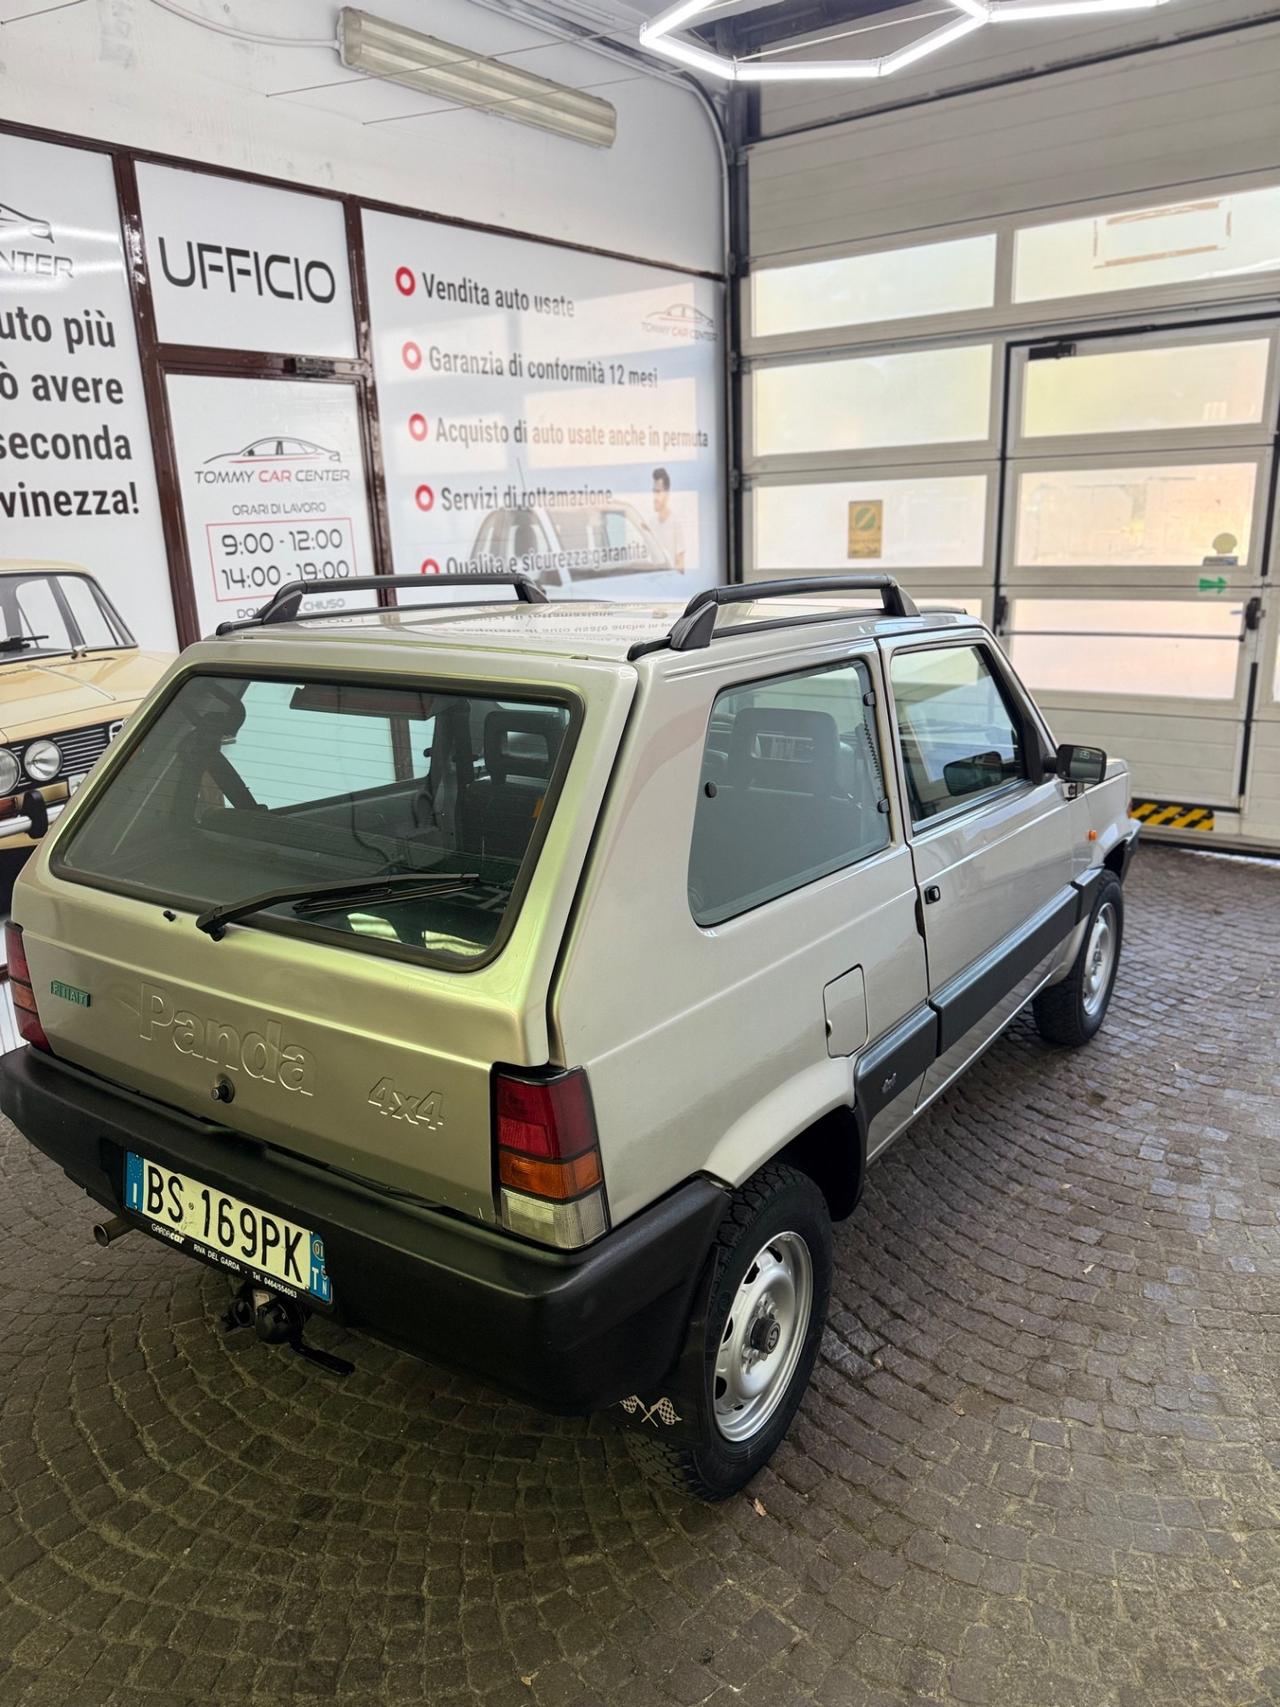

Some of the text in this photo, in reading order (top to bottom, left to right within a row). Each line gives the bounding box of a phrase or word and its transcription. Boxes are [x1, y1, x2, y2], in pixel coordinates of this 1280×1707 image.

[158, 236, 336, 304] UFFICIO
[422, 272, 575, 317] Vendita auto usate
[64, 309, 116, 354] più
[429, 346, 658, 388] Garanzia di conformità 12 mesi
[31, 373, 124, 404] avere
[436, 417, 708, 451] Acquisto di auto usate anche in permuta
[194, 468, 350, 484] TOMMY CAR CENTER
[232, 502, 327, 516] ORARI DI LAVORO
[441, 485, 613, 511] Servizi di rottamazione
[221, 532, 274, 556] 9:00
[289, 528, 343, 551] 12:00
[221, 565, 281, 590] 14:00
[296, 560, 350, 581] 19:00
[508, 556, 518, 573] e
[522, 548, 588, 572] sicurezza
[304, 598, 346, 612] CHIUSO
[52, 982, 86, 1004] FIAT
[139, 981, 318, 1096] Panda
[368, 1076, 447, 1131] 4x4
[147, 1166, 302, 1283] BS 169PK
[193, 1244, 206, 1255] RIVA
[207, 1251, 219, 1261] DEL
[220, 1256, 241, 1272] GARDA
